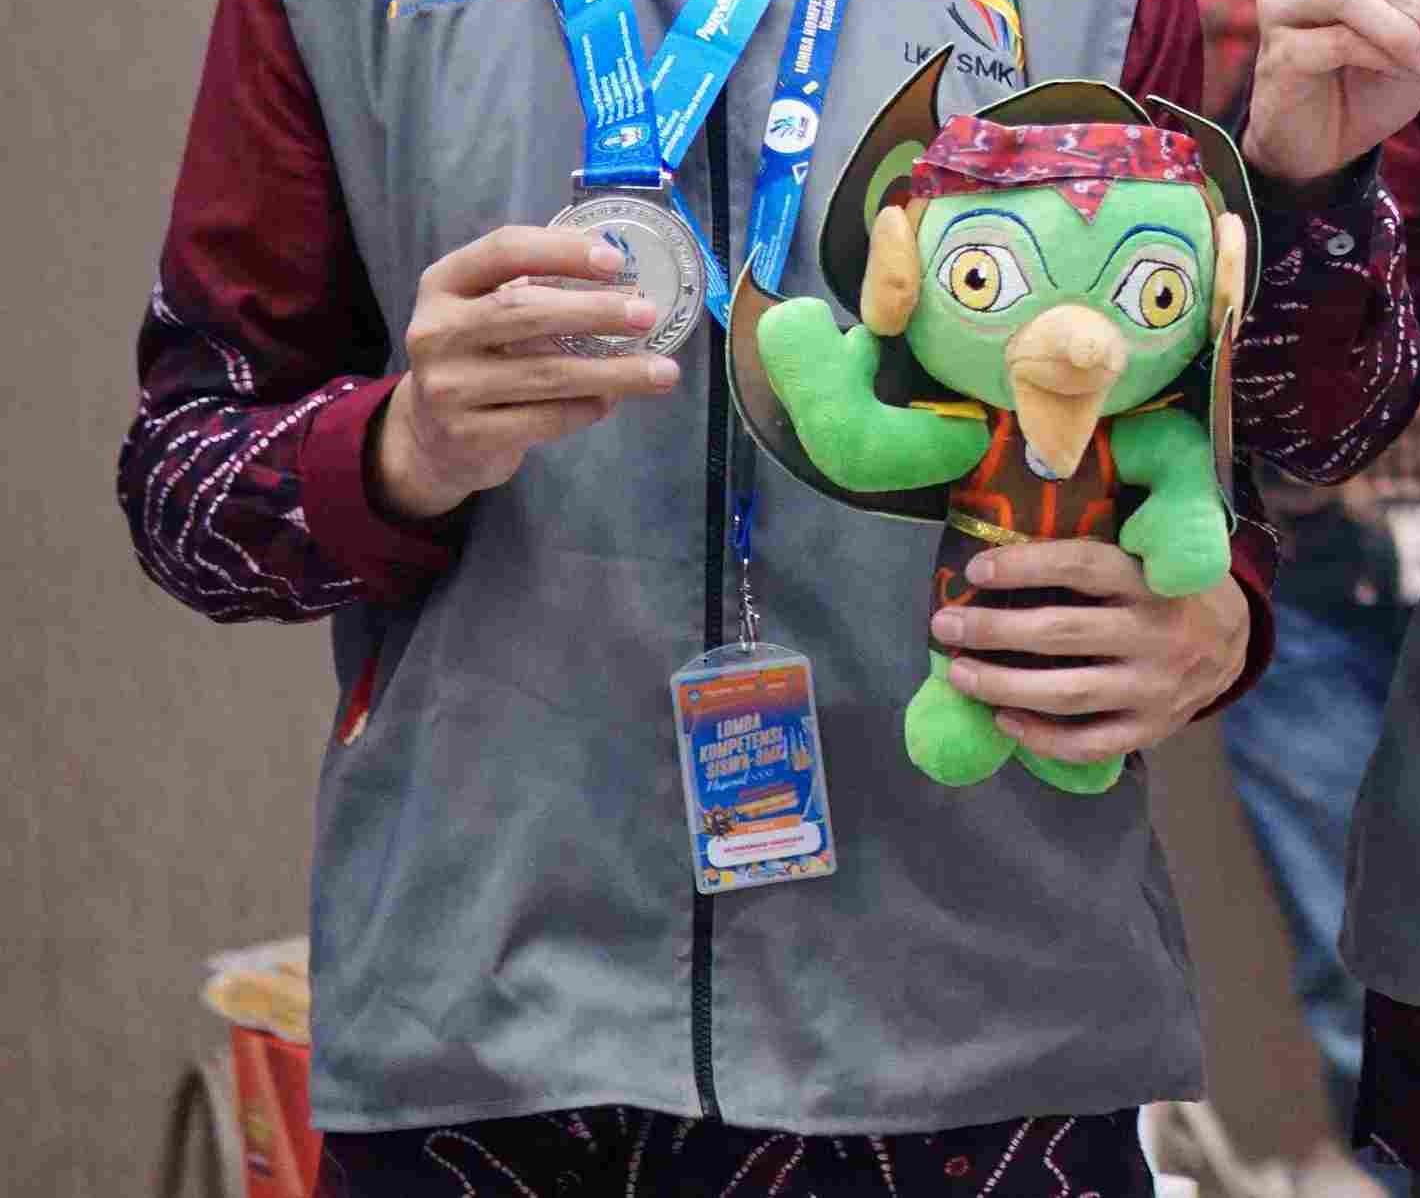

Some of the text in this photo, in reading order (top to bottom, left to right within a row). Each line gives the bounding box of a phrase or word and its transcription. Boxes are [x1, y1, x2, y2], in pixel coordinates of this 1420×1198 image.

[904, 42, 1015, 87] LK SMK
[716, 713, 761, 738] LOMBA
[700, 727, 783, 763] KOMPETENSI
